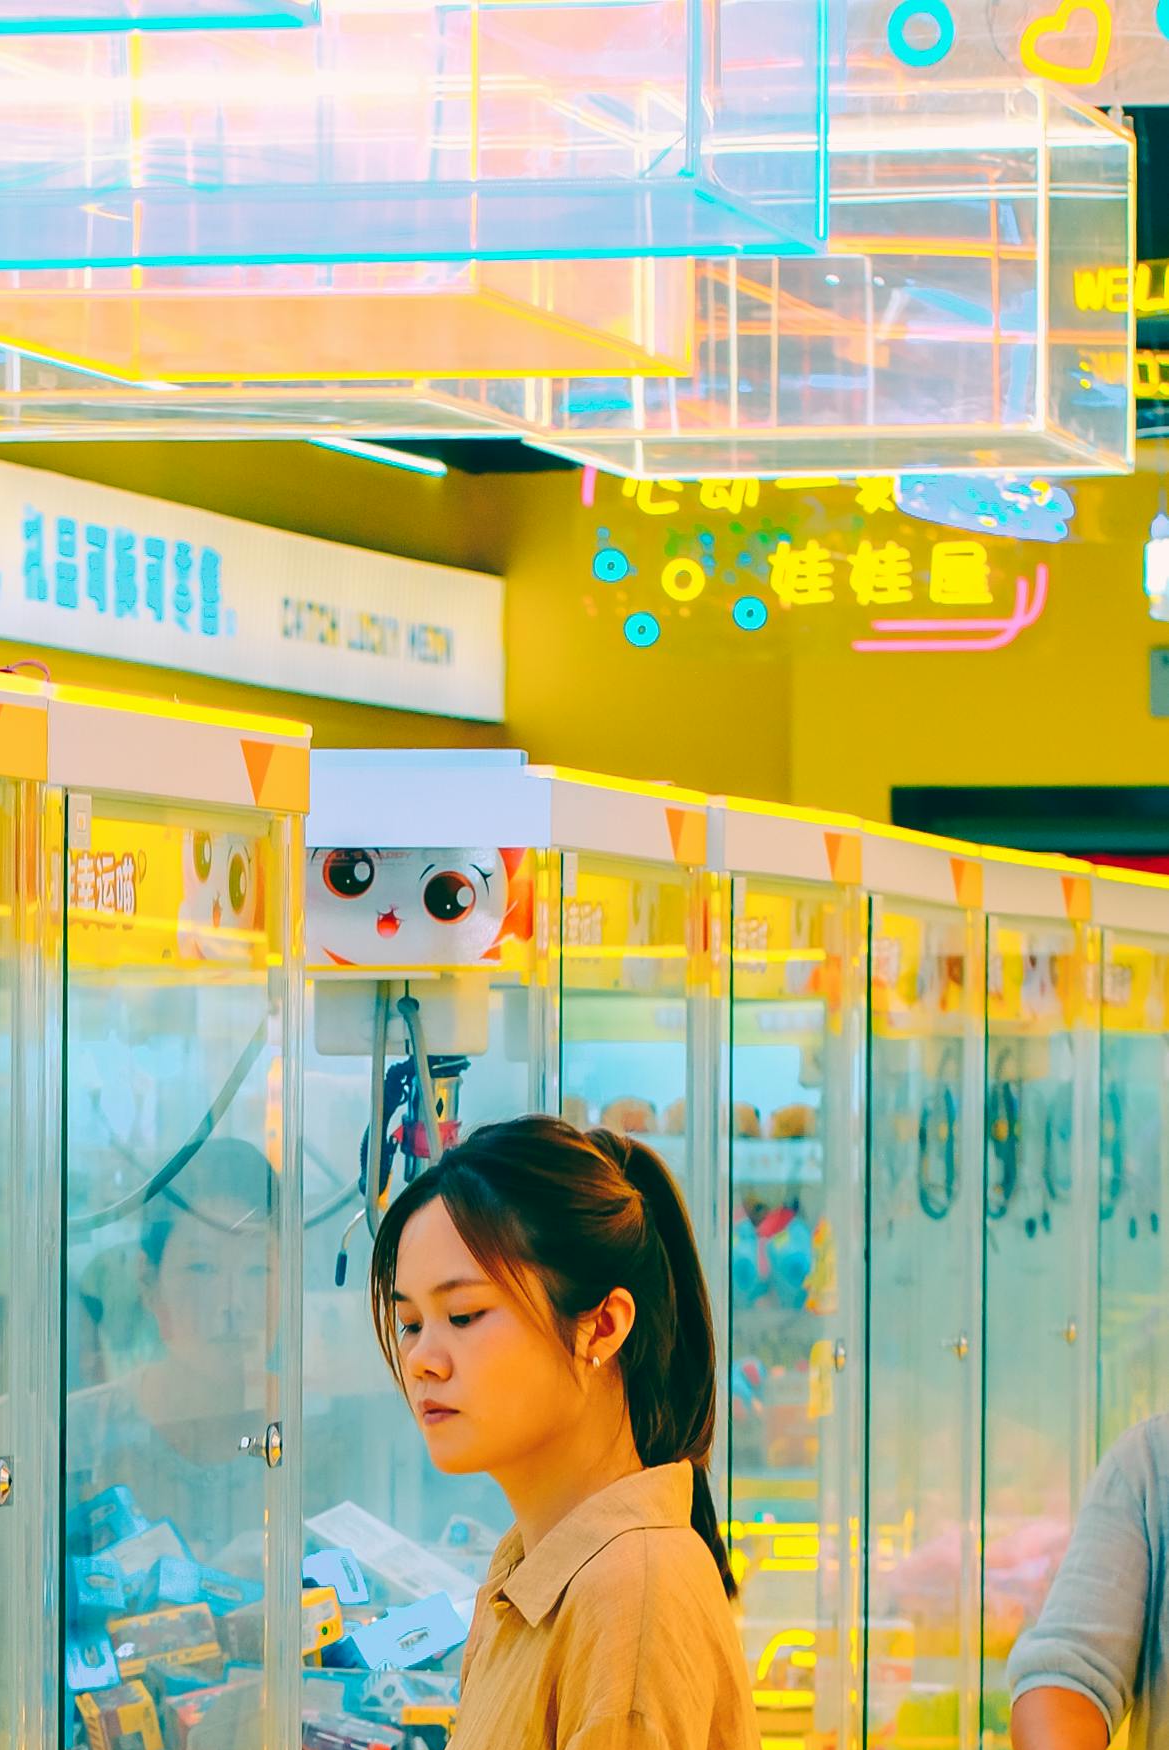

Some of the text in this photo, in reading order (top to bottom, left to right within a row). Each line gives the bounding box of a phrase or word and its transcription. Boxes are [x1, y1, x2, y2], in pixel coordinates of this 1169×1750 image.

[1074, 264, 1169, 313] WEL
[770, 540, 993, 605] 娃娃屋
